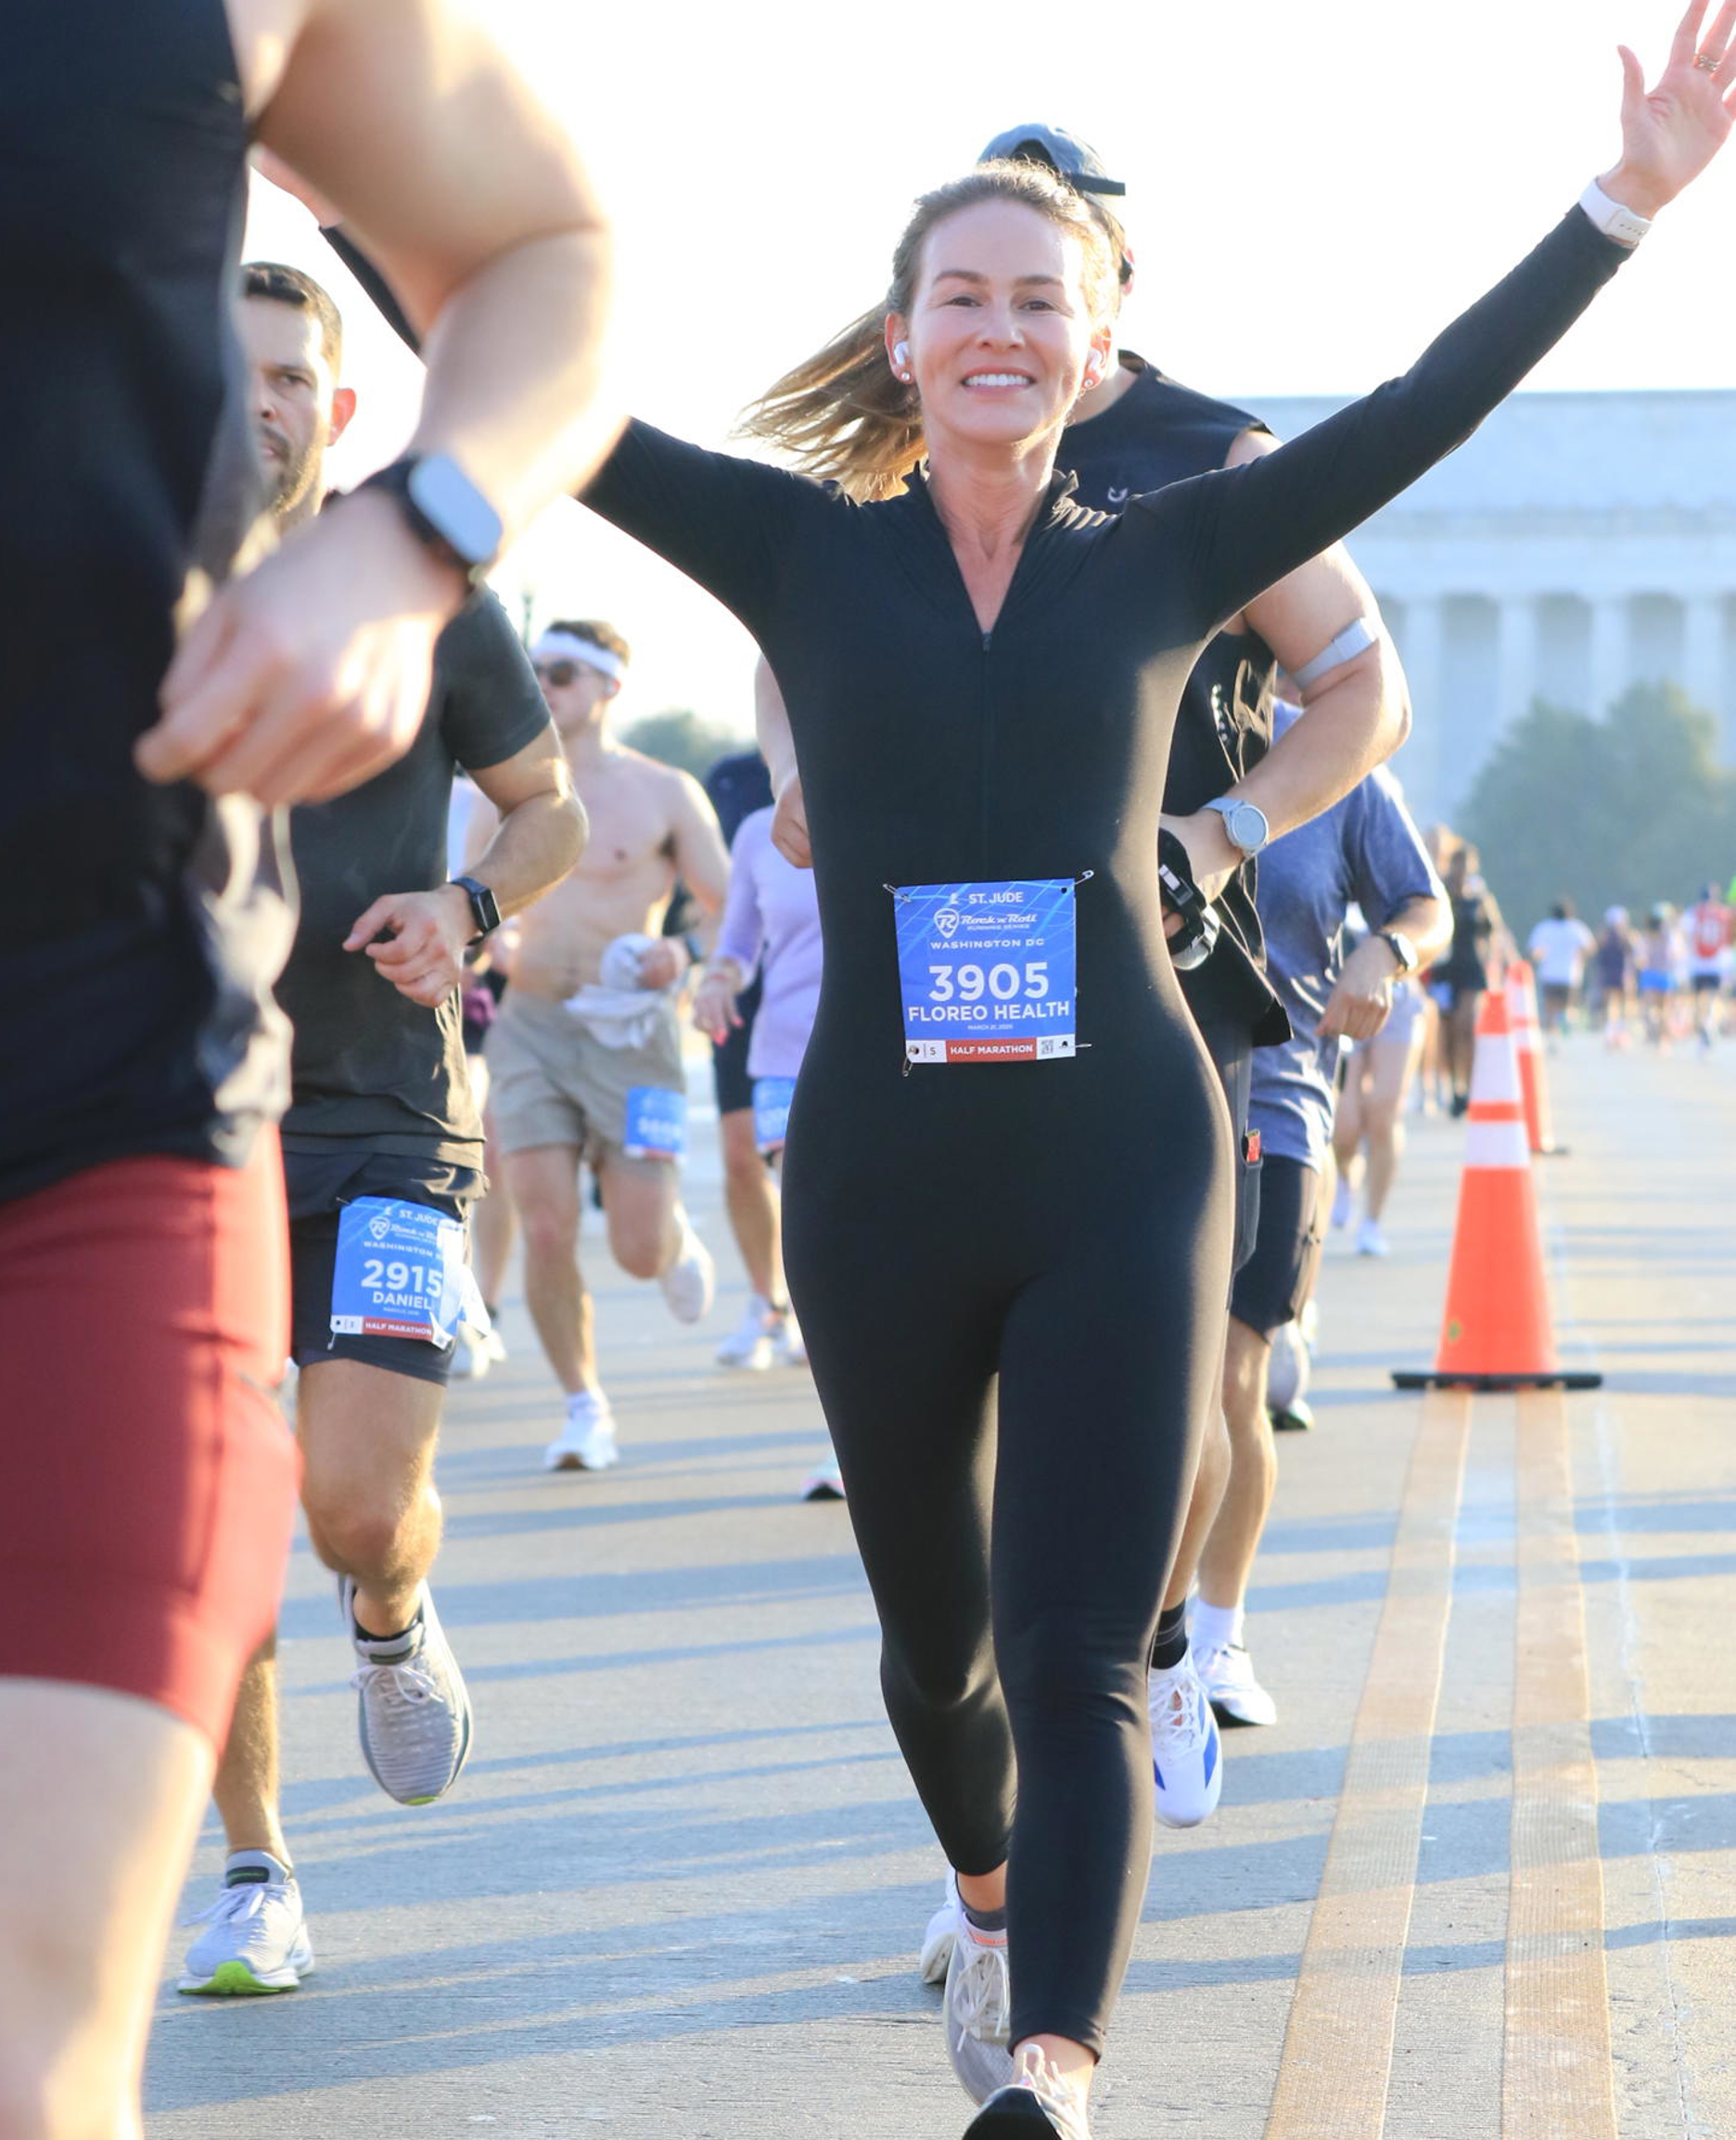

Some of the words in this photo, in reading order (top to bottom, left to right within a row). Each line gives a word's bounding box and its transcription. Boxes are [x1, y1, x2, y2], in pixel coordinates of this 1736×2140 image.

[969, 893, 988, 904] ST.
[989, 891, 1024, 903] JUDE
[961, 915, 996, 925] Rock
[1006, 913, 1038, 923] Roll
[930, 939, 1021, 950] WASHINGTON
[1025, 938, 1045, 946] DC
[928, 962, 1049, 1002] 3905
[908, 1005, 988, 1022] FLOREO
[994, 1001, 1069, 1019] HEALTH
[950, 1045, 976, 1055] HALF
[977, 1044, 1033, 1054] MARATHON
[364, 1241, 433, 1257] WASHINGTON
[361, 1259, 443, 1299] 2915
[373, 1290, 432, 1310] DANIEL
[364, 1322, 387, 1331] HALF
[388, 1324, 432, 1336] MARATHON
